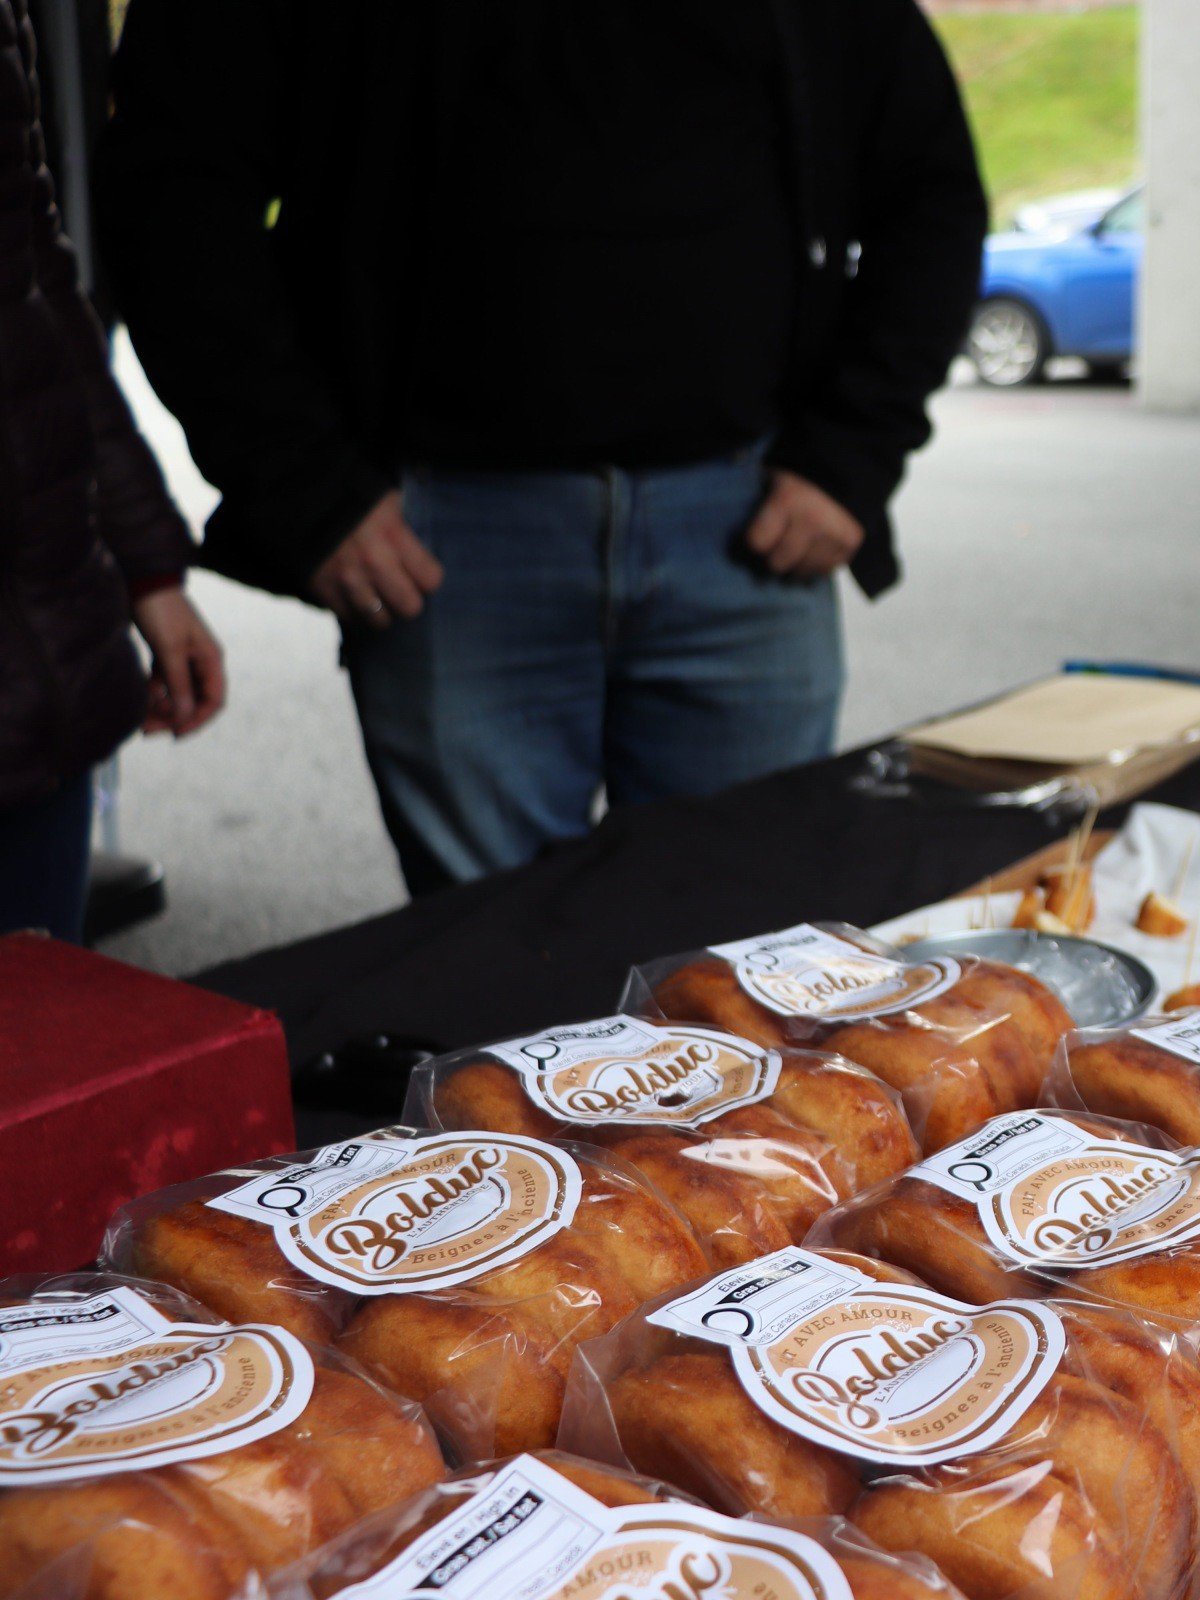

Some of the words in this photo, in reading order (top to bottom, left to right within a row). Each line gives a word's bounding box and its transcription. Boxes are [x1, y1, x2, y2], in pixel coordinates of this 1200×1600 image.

[567, 1044, 712, 1115] Bolduc
[326, 1147, 499, 1270] Bolduc
[1034, 1166, 1172, 1251] Bolduc
[1036, 1166, 1063, 1190] AVEC
[412, 1232, 494, 1264] Beignes
[794, 1316, 837, 1347] AVEC
[841, 1308, 912, 1323] AMOUR
[0, 1337, 228, 1454] Bolduc
[792, 1320, 966, 1429] Bolduc
[895, 1393, 979, 1438] Beignes
[985, 1322, 1015, 1378] l'ancienne
